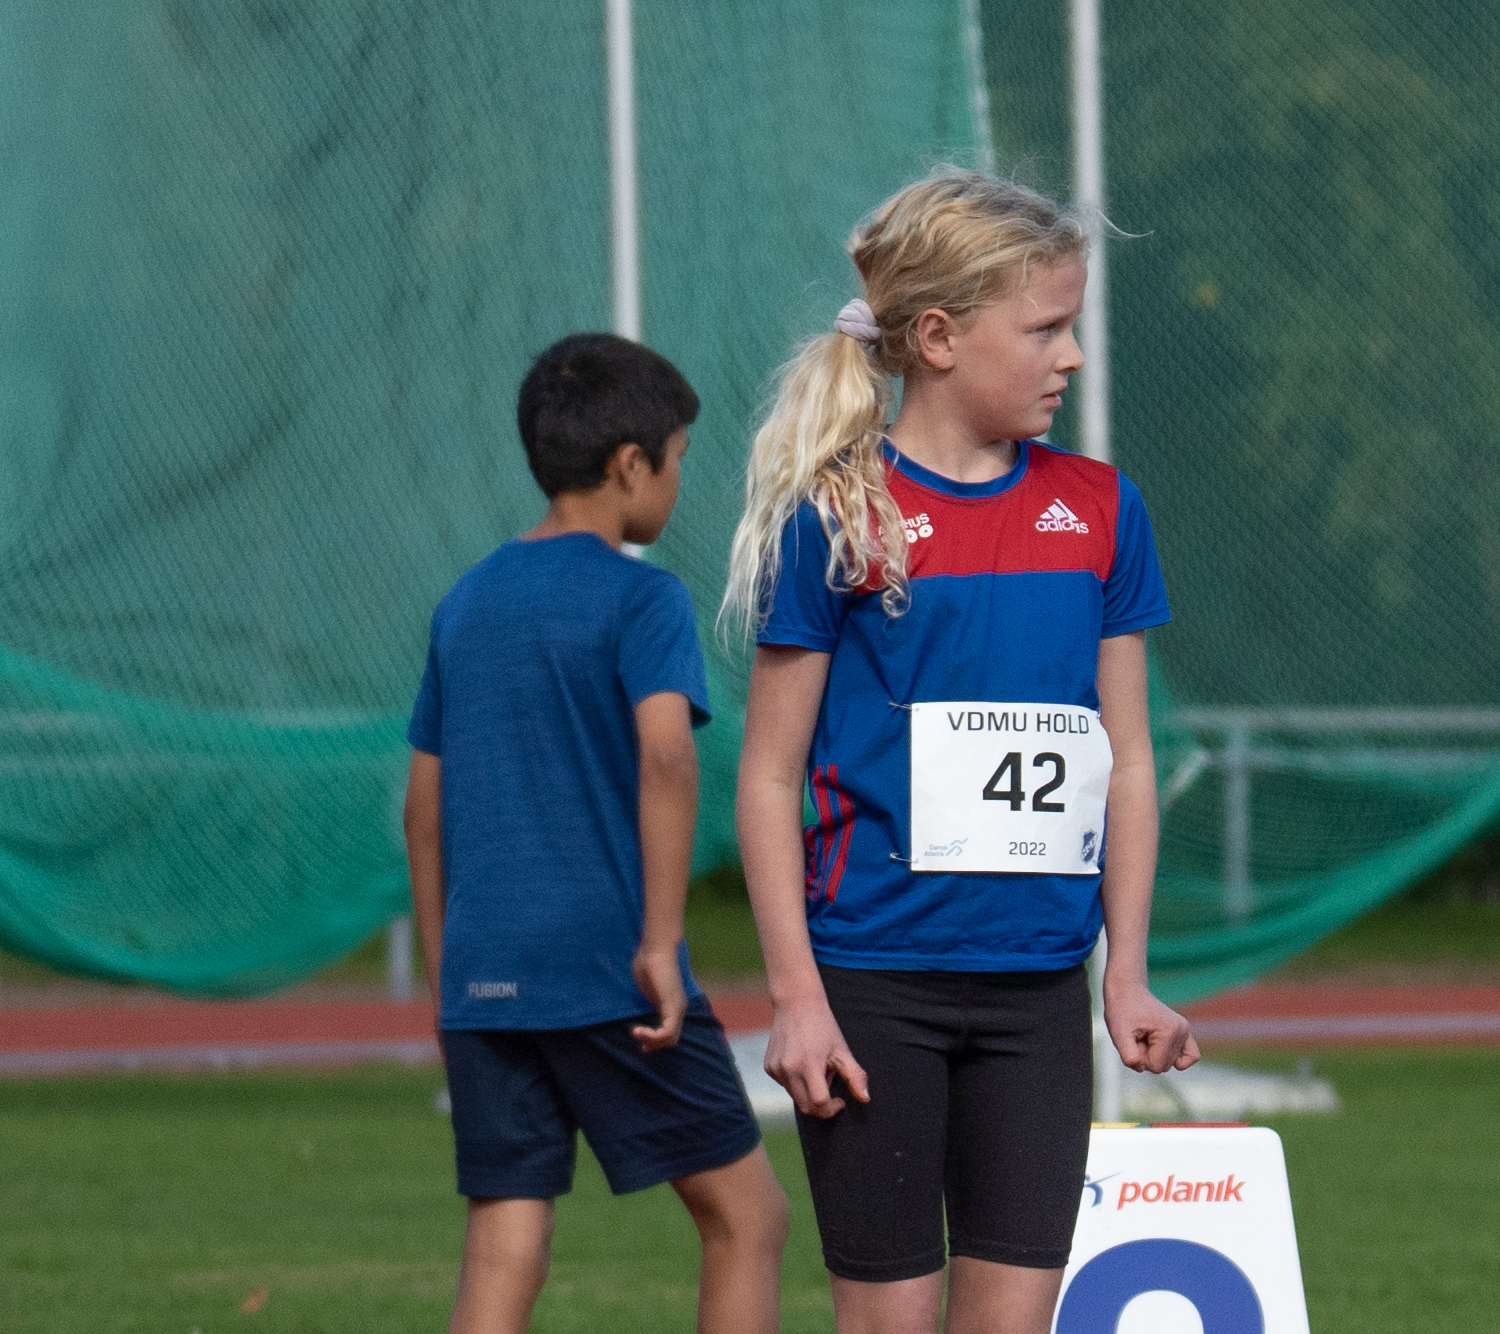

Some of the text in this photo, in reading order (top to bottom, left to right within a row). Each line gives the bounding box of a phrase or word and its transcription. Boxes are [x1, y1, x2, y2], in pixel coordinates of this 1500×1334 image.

[946, 711, 1090, 735] VDMU HOLD
[982, 751, 1066, 813] 42
[1008, 841, 1047, 856] 2022
[466, 980, 518, 998] FUSION
[1116, 1173, 1247, 1211] polanik
